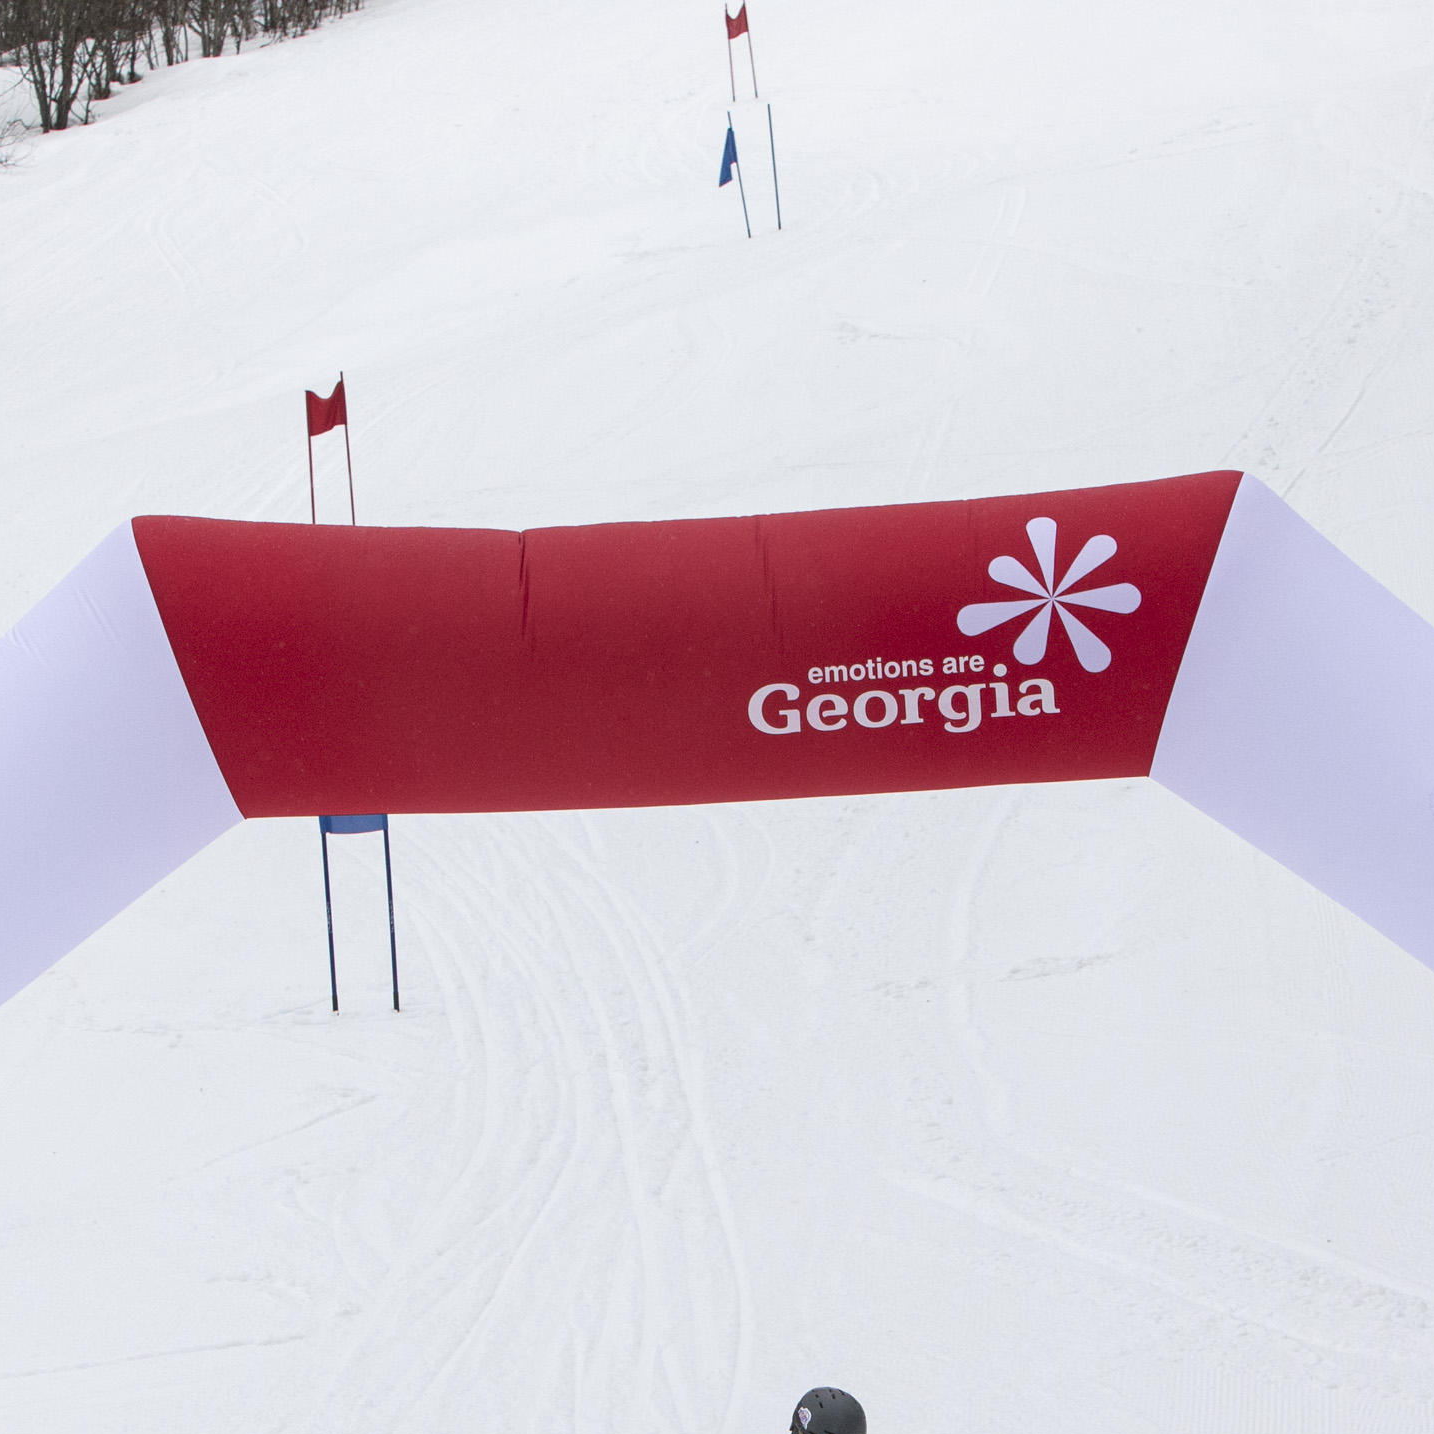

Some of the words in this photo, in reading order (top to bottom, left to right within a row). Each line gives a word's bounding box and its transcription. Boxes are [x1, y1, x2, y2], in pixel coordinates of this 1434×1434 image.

[808, 656, 934, 684] emotions
[942, 653, 985, 675] are
[747, 663, 1061, 735] Georgia
